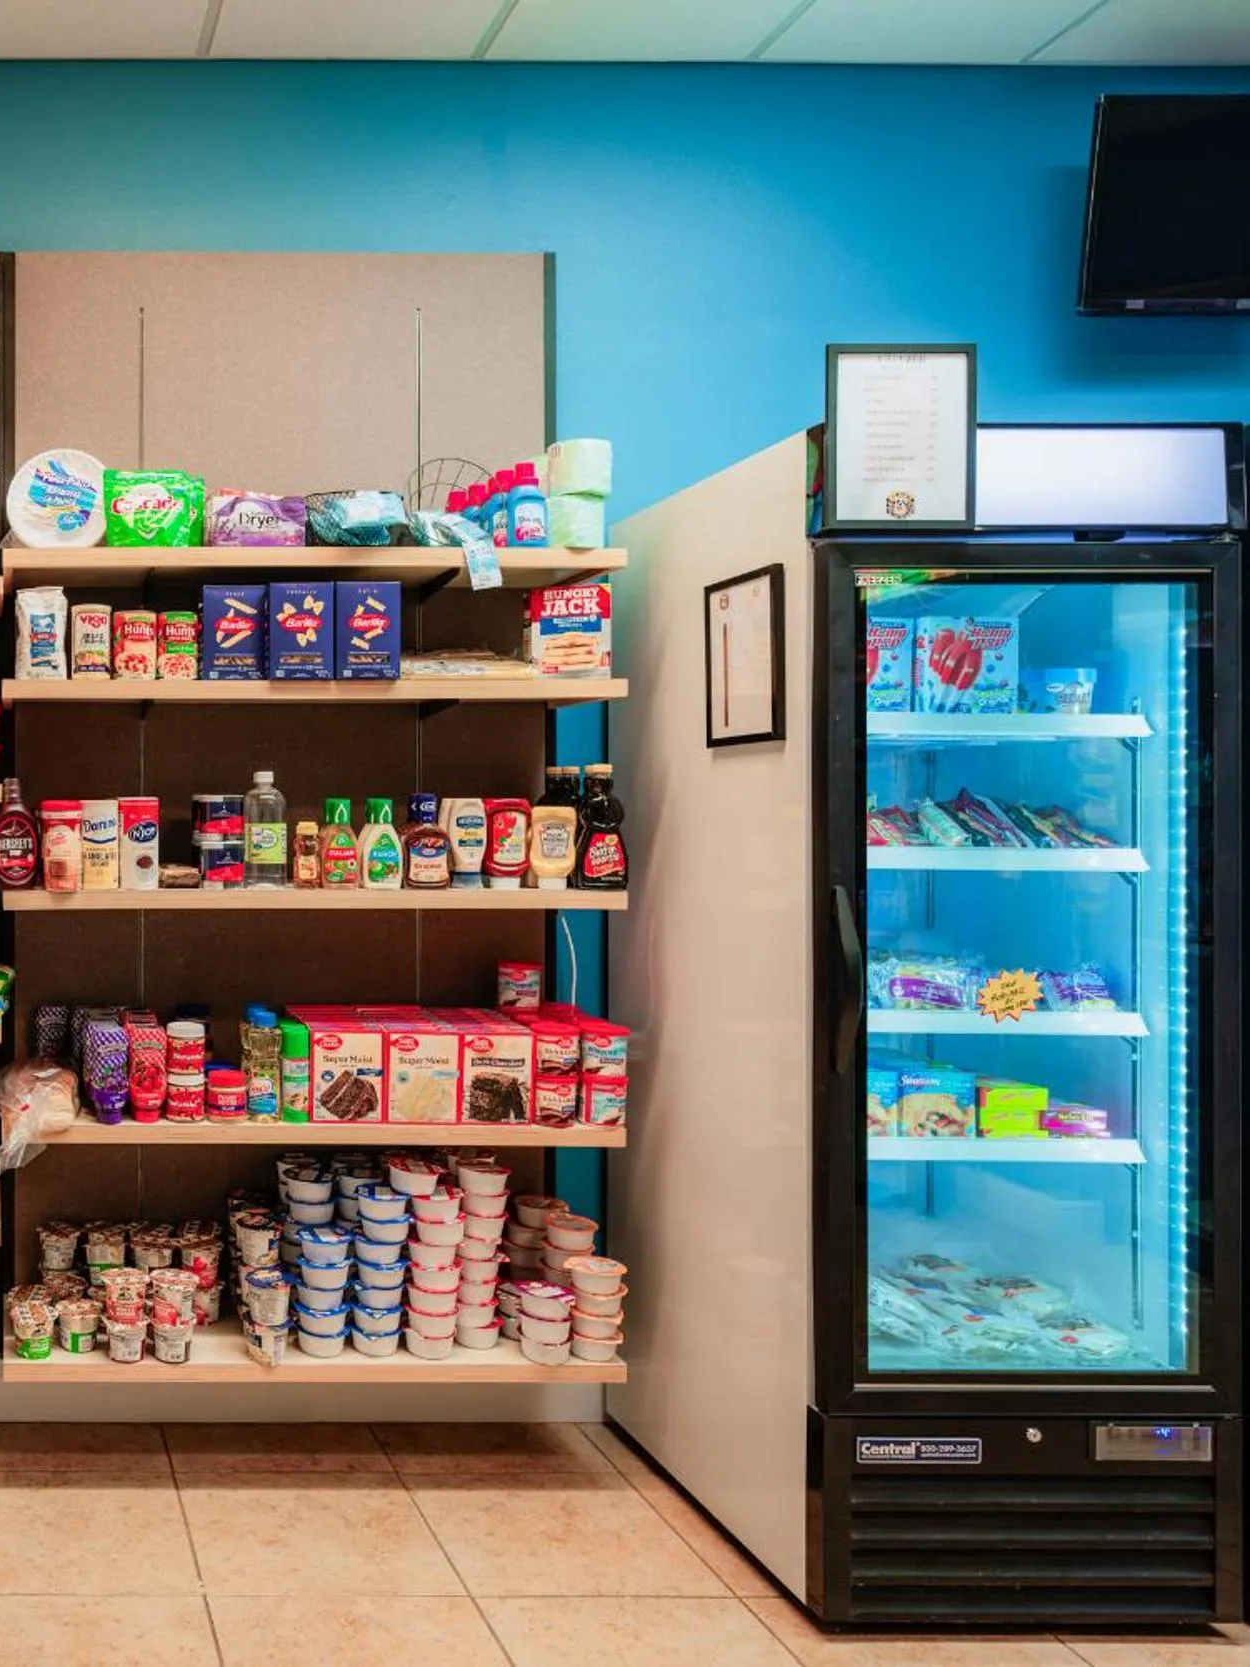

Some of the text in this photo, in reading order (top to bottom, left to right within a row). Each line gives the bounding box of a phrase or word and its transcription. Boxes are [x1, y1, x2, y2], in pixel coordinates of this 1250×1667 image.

[239, 511, 280, 530] Dryer
[856, 575, 900, 585] FREEZER
[543, 586, 600, 600] HUNGRY
[541, 597, 603, 616] JACK
[79, 614, 108, 629] VIGO
[285, 618, 319, 629] Barilla
[322, 1055, 348, 1064] Super
[399, 1056, 424, 1065] Super
[861, 1442, 916, 1455] Central
